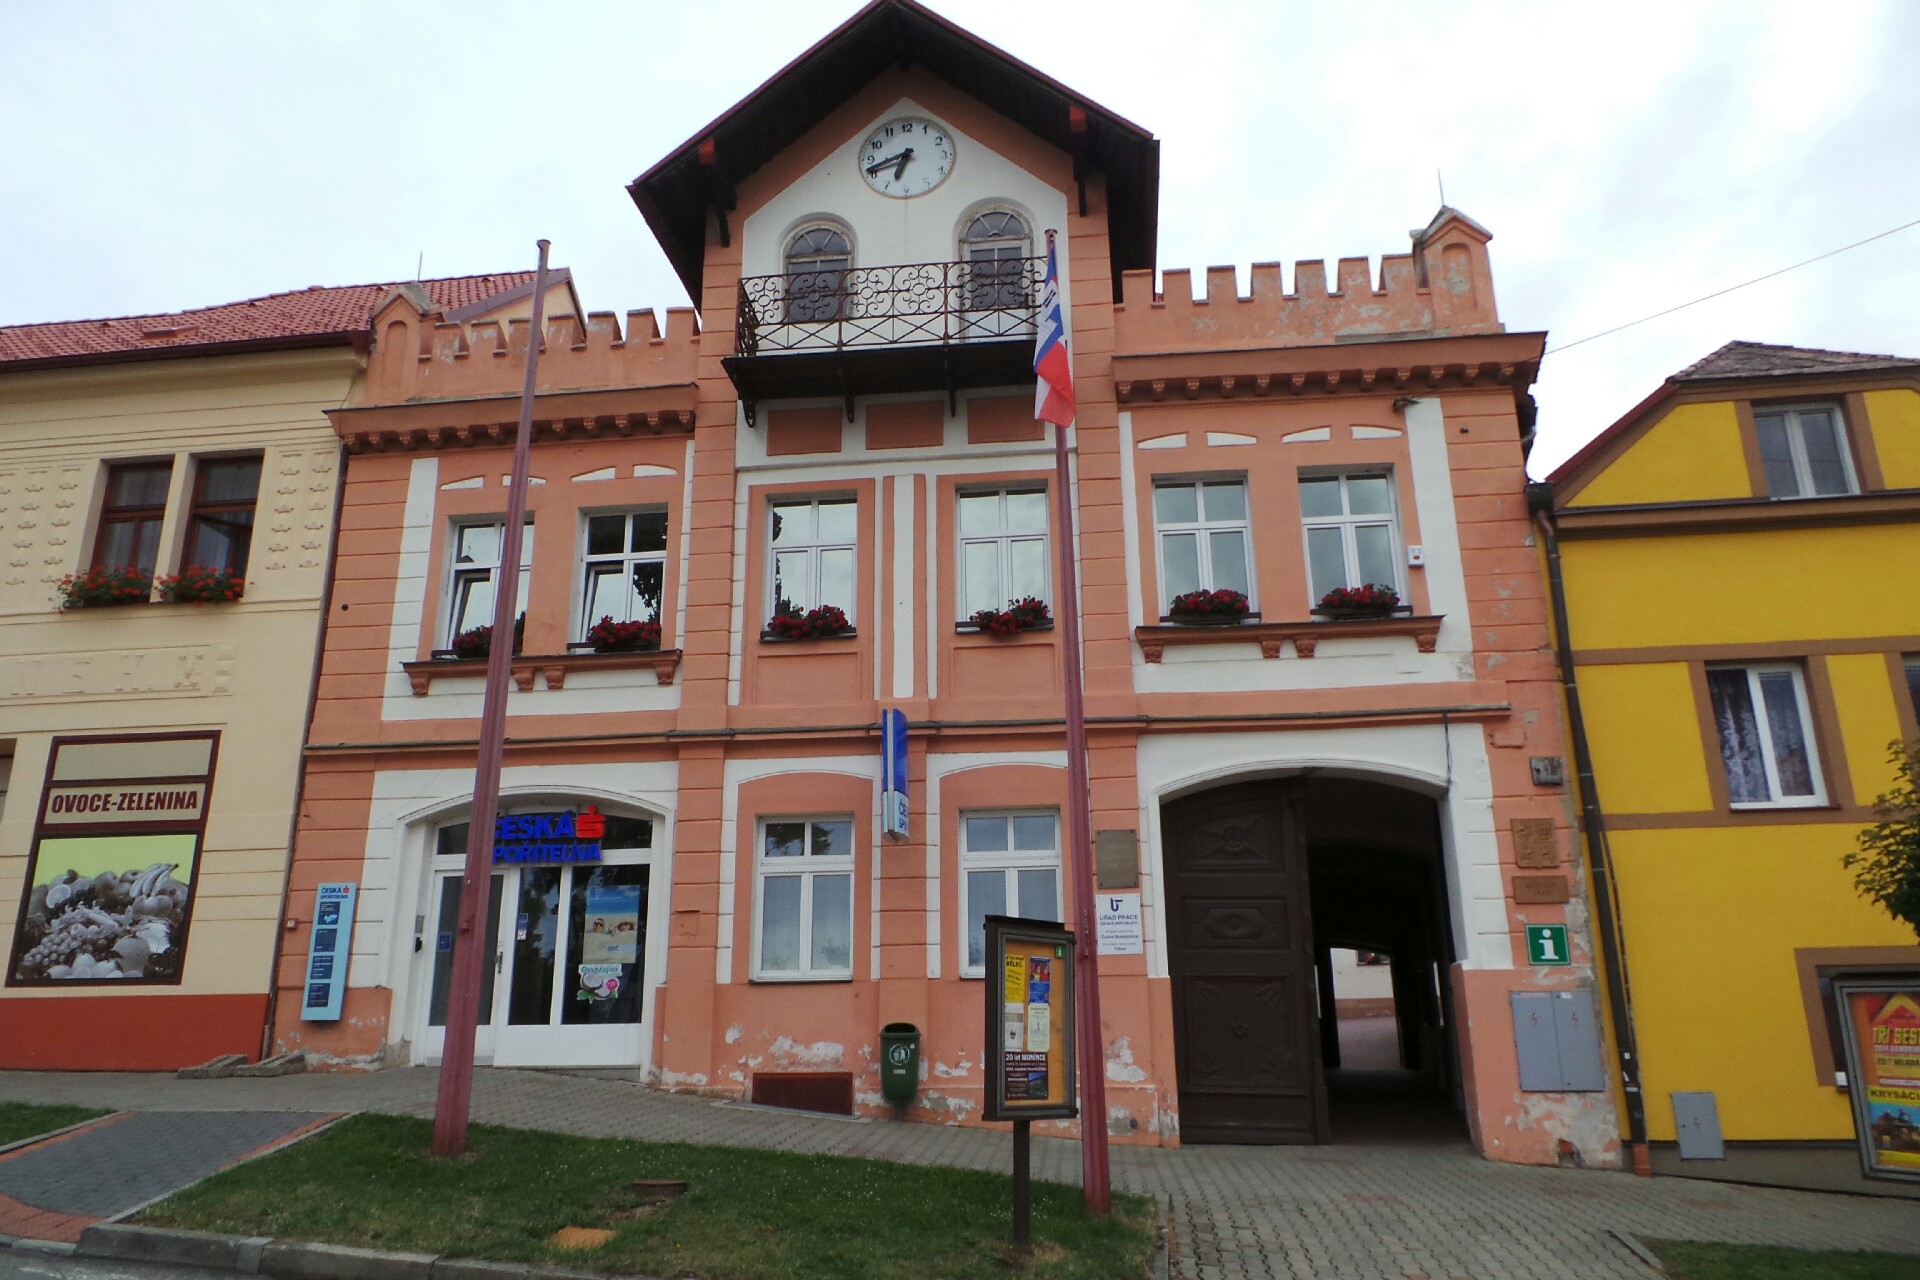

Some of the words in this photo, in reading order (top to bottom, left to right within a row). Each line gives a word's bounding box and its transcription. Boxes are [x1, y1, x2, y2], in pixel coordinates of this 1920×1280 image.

[885, 127, 894, 137] 11
[901, 123, 913, 133] 12
[923, 124, 928, 134] 1
[871, 140, 883, 150] 10
[935, 136, 943, 146] 2
[867, 155, 875, 164] 9
[941, 150, 948, 159] 3
[51, 790, 198, 813] OVOCE-ZELENINA
[492, 841, 602, 865] POŘITELNA
